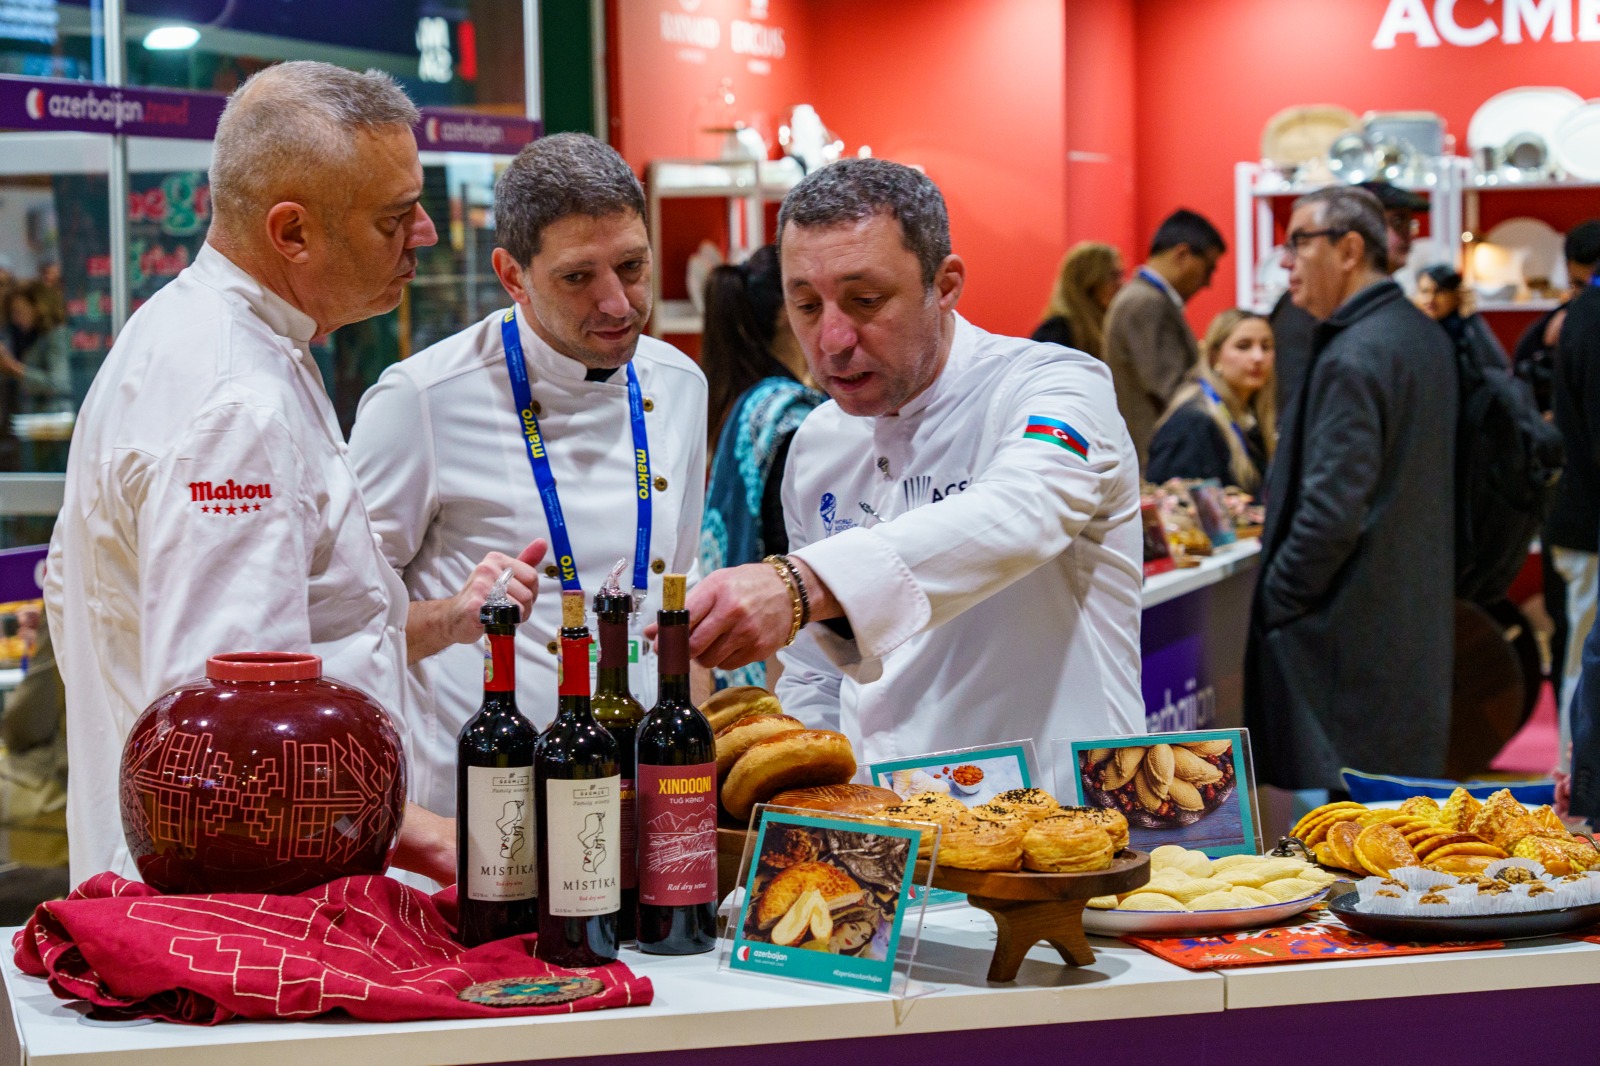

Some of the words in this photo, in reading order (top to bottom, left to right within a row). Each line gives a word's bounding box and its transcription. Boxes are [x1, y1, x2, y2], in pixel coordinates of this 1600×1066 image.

[521, 408, 545, 459] makro
[636, 448, 650, 500] makro
[188, 479, 272, 502] Mahou
[560, 555, 575, 582] kro
[659, 775, 712, 795] XINDOQNI
[667, 883, 682, 891] Red
[681, 881, 693, 894] dry
[753, 949, 788, 962] azerbaijan
